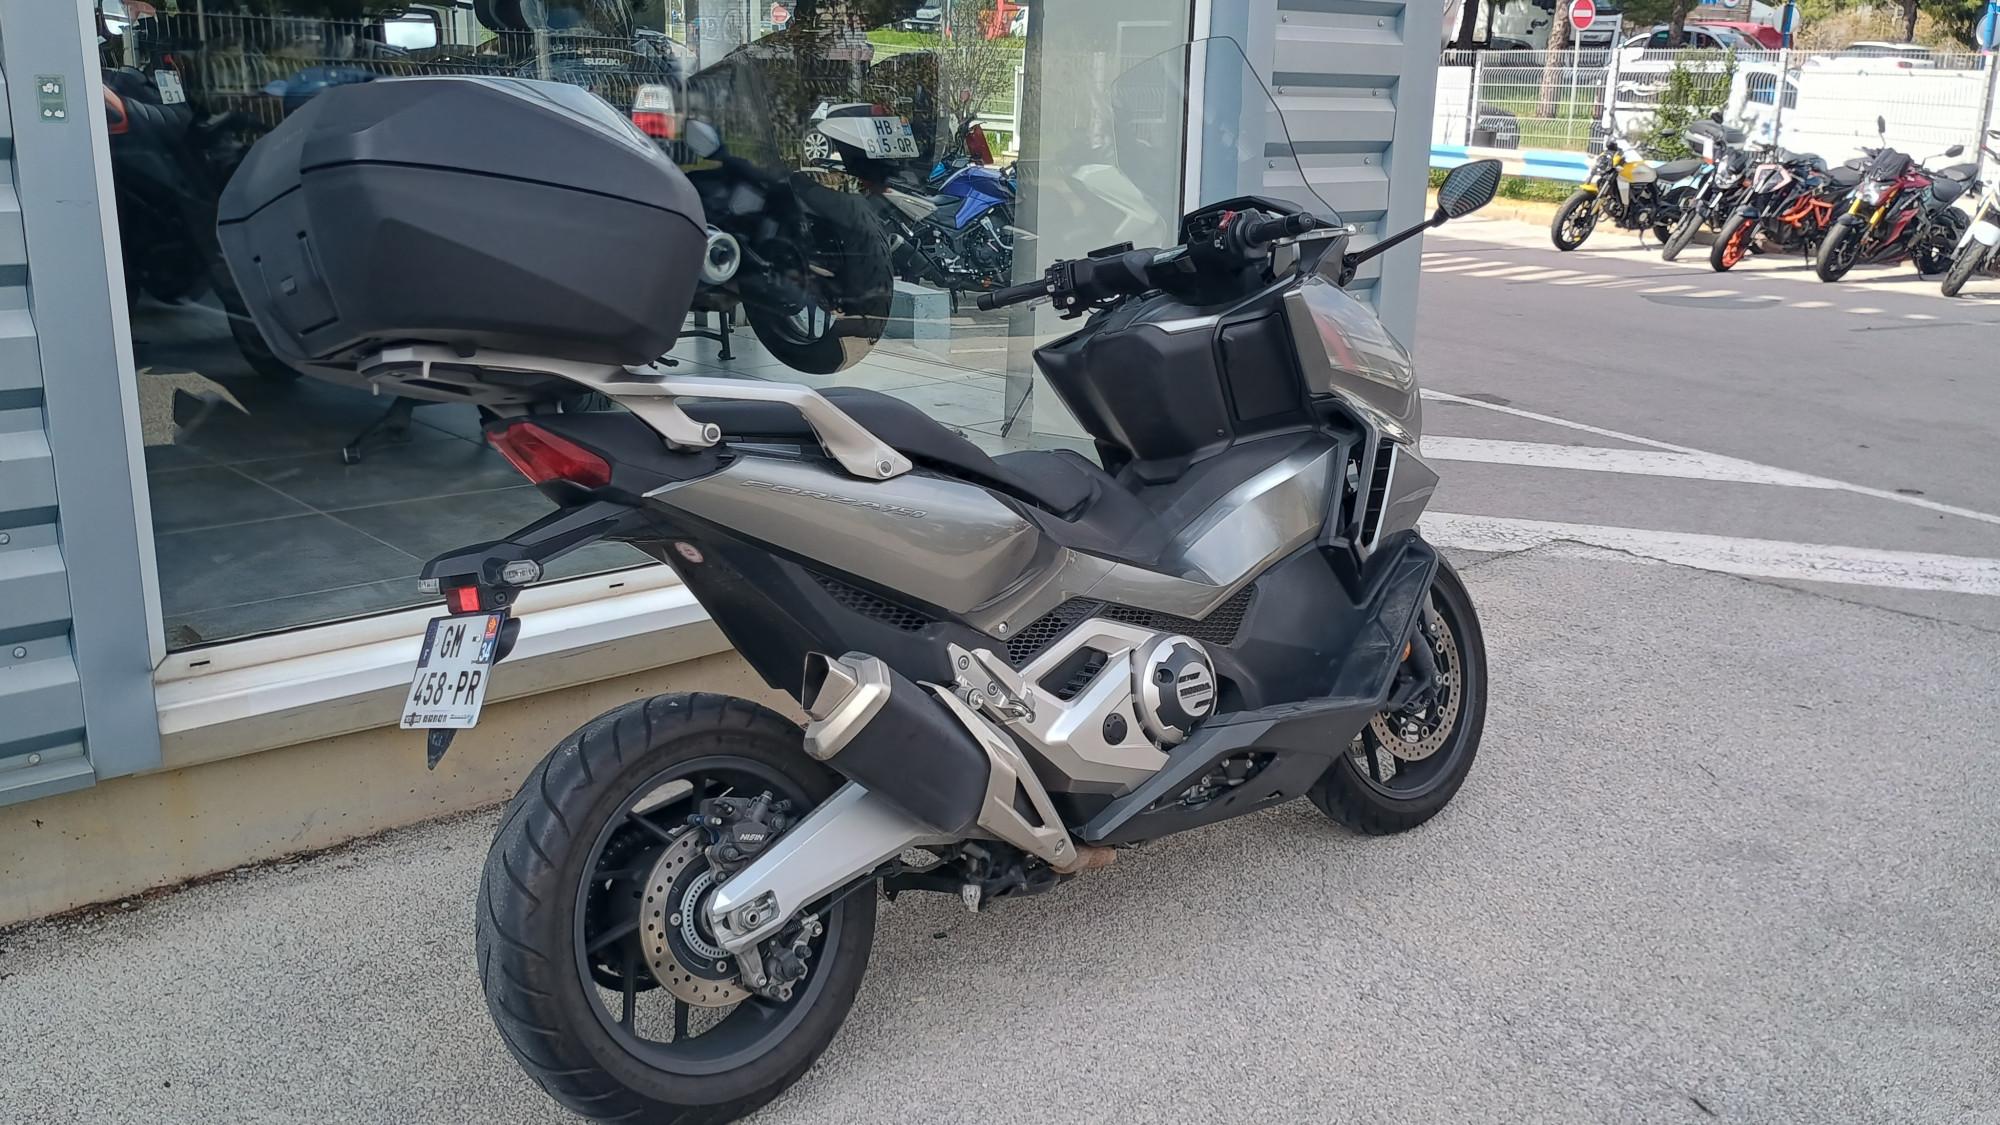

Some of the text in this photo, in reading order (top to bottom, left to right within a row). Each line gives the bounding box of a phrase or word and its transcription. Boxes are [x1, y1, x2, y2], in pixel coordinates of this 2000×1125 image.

[583, 57, 621, 66] SUZUKI
[479, 641, 493, 662] 34
[413, 670, 482, 707] 458-PR
